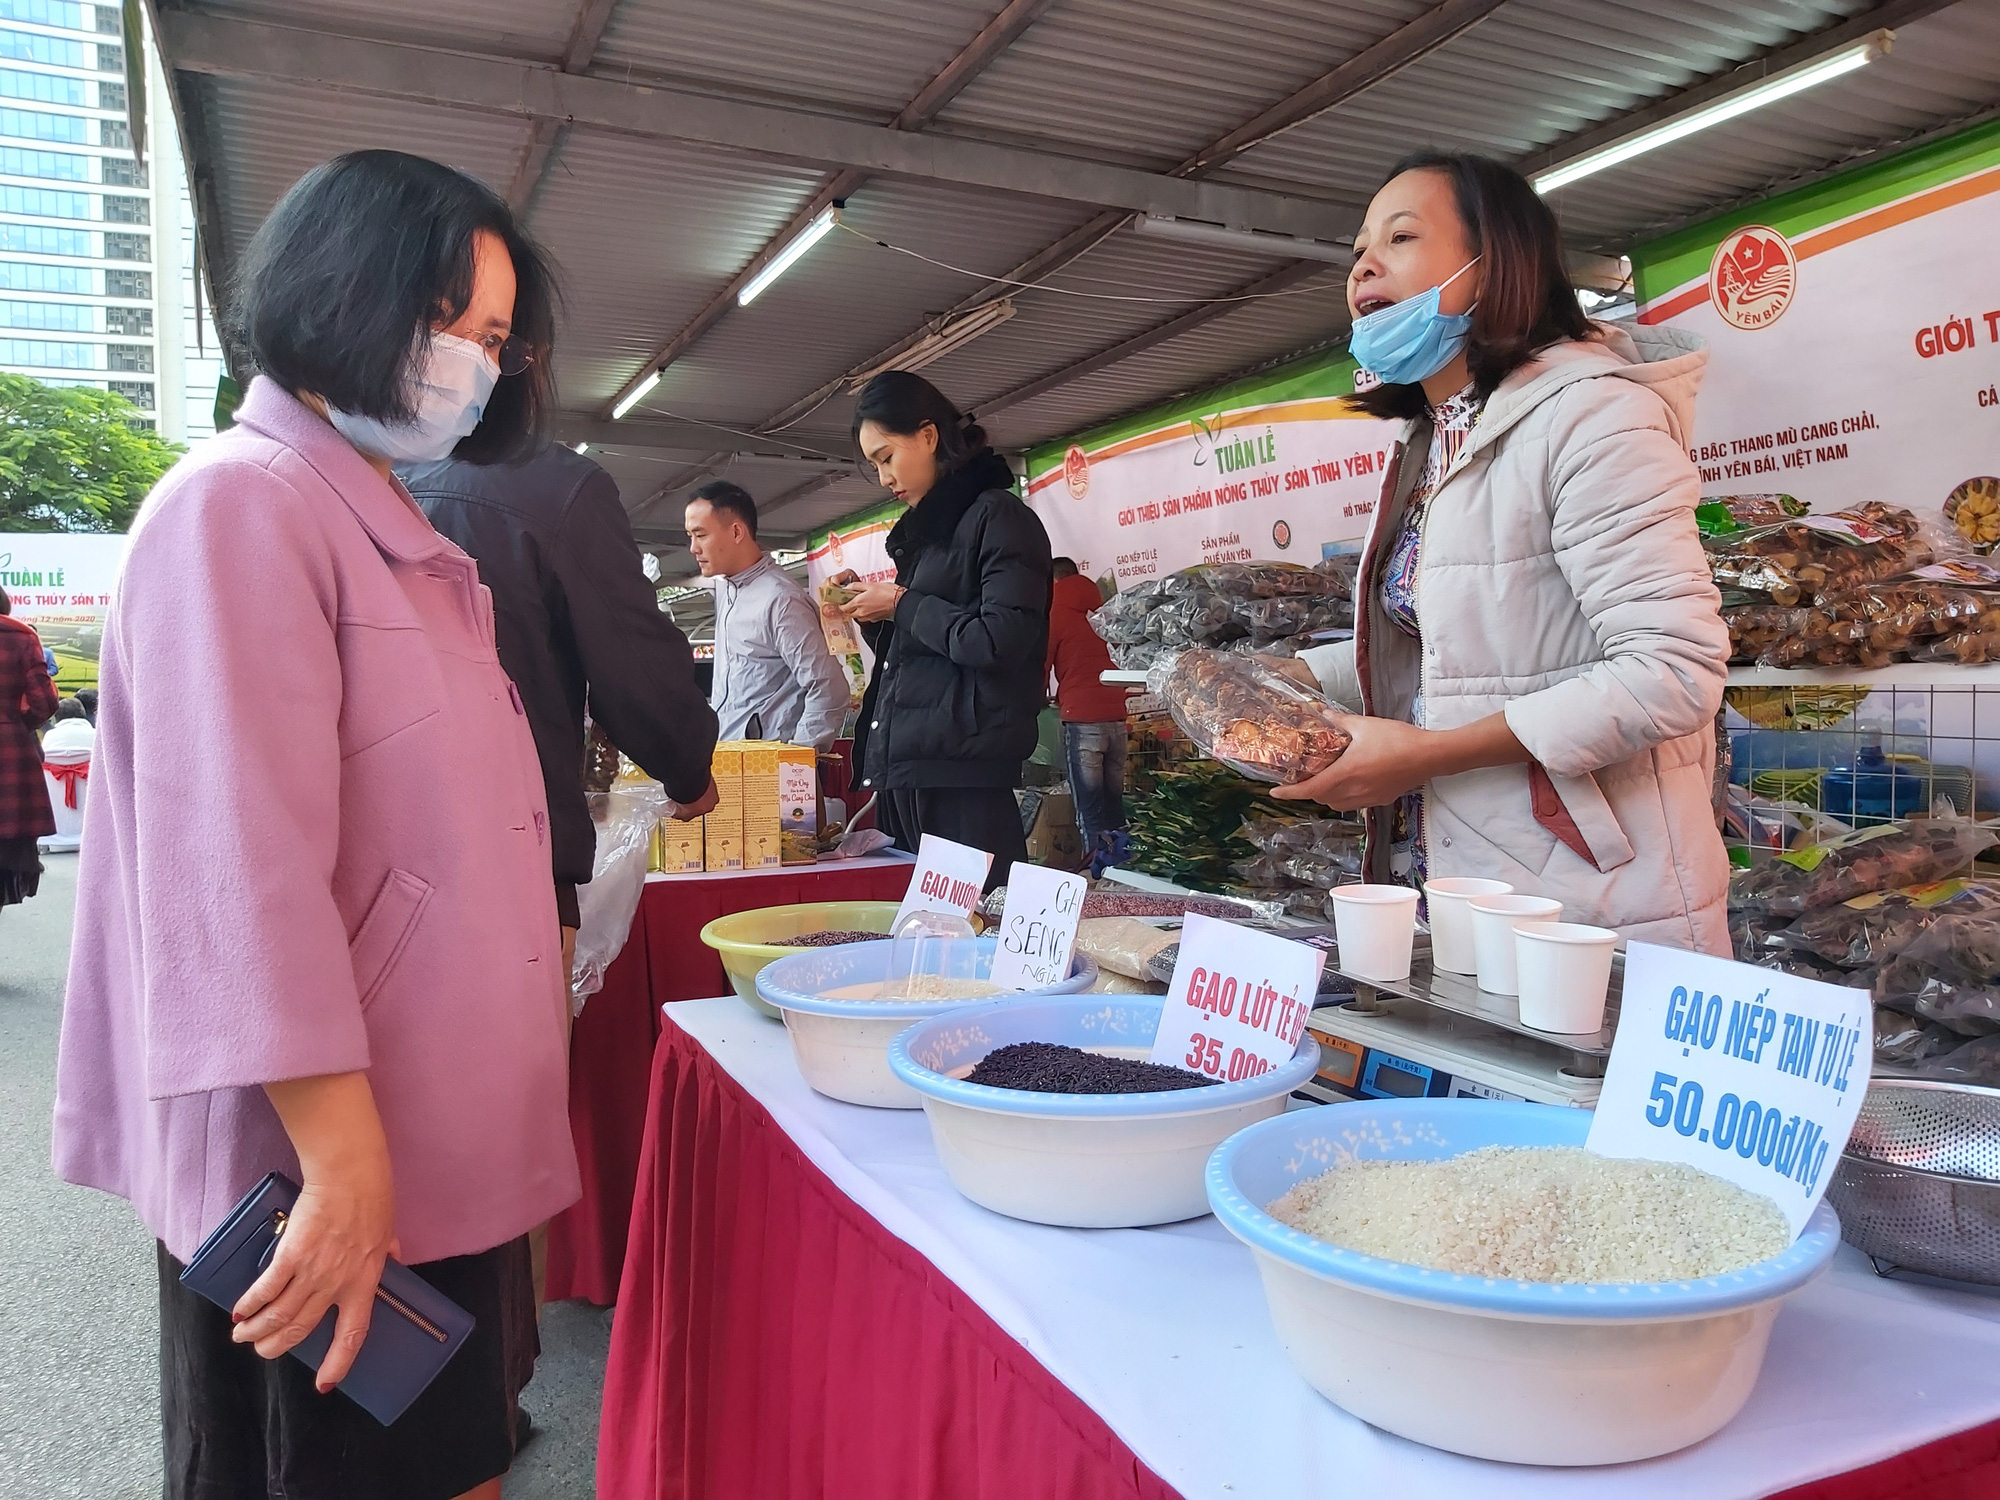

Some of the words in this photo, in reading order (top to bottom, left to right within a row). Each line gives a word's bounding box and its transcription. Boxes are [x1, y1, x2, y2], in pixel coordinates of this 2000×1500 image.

[1736, 311, 1761, 324] YÊN
[1915, 314, 1975, 358] GIỚI
[1355, 369, 1376, 386] CE
[1215, 433, 1256, 474] TUẦN
[1257, 425, 1276, 464] LỄ
[1701, 442, 1727, 462] BẬC
[1730, 434, 1773, 454] THANG
[1776, 426, 1798, 447] MÙ
[1801, 420, 1838, 441] CANG
[1841, 410, 1880, 434] CHẢI,
[1163, 495, 1181, 518] SẢN
[1182, 485, 1213, 513] PHẨM
[1250, 471, 1280, 498] THỦY
[1285, 465, 1310, 491] SẢN
[1312, 459, 1341, 485] TỈNH
[1344, 451, 1374, 478] YÊN
[1698, 465, 1721, 484] ỈNH
[1724, 460, 1751, 479] YÊN
[1754, 454, 1780, 474] BÁI,
[1782, 448, 1812, 469] VIỆT
[1816, 443, 1848, 463] NAM
[0, 566, 43, 587] TUẦN
[48, 567, 65, 587] LỄ
[920, 870, 950, 902] GẠO
[1186, 967, 1238, 1021] GẠO
[1239, 979, 1279, 1032] LỨT
[1275, 984, 1299, 1042] TẺ
[1664, 985, 1723, 1058] GẠO
[1723, 988, 1777, 1064] NẾP
[1776, 1012, 1819, 1083] TAN
[1814, 1013, 1846, 1086] TÚ
[1833, 1016, 1862, 1107] LỆ
[1645, 1071, 1830, 1198] 50.000đ/Kg
